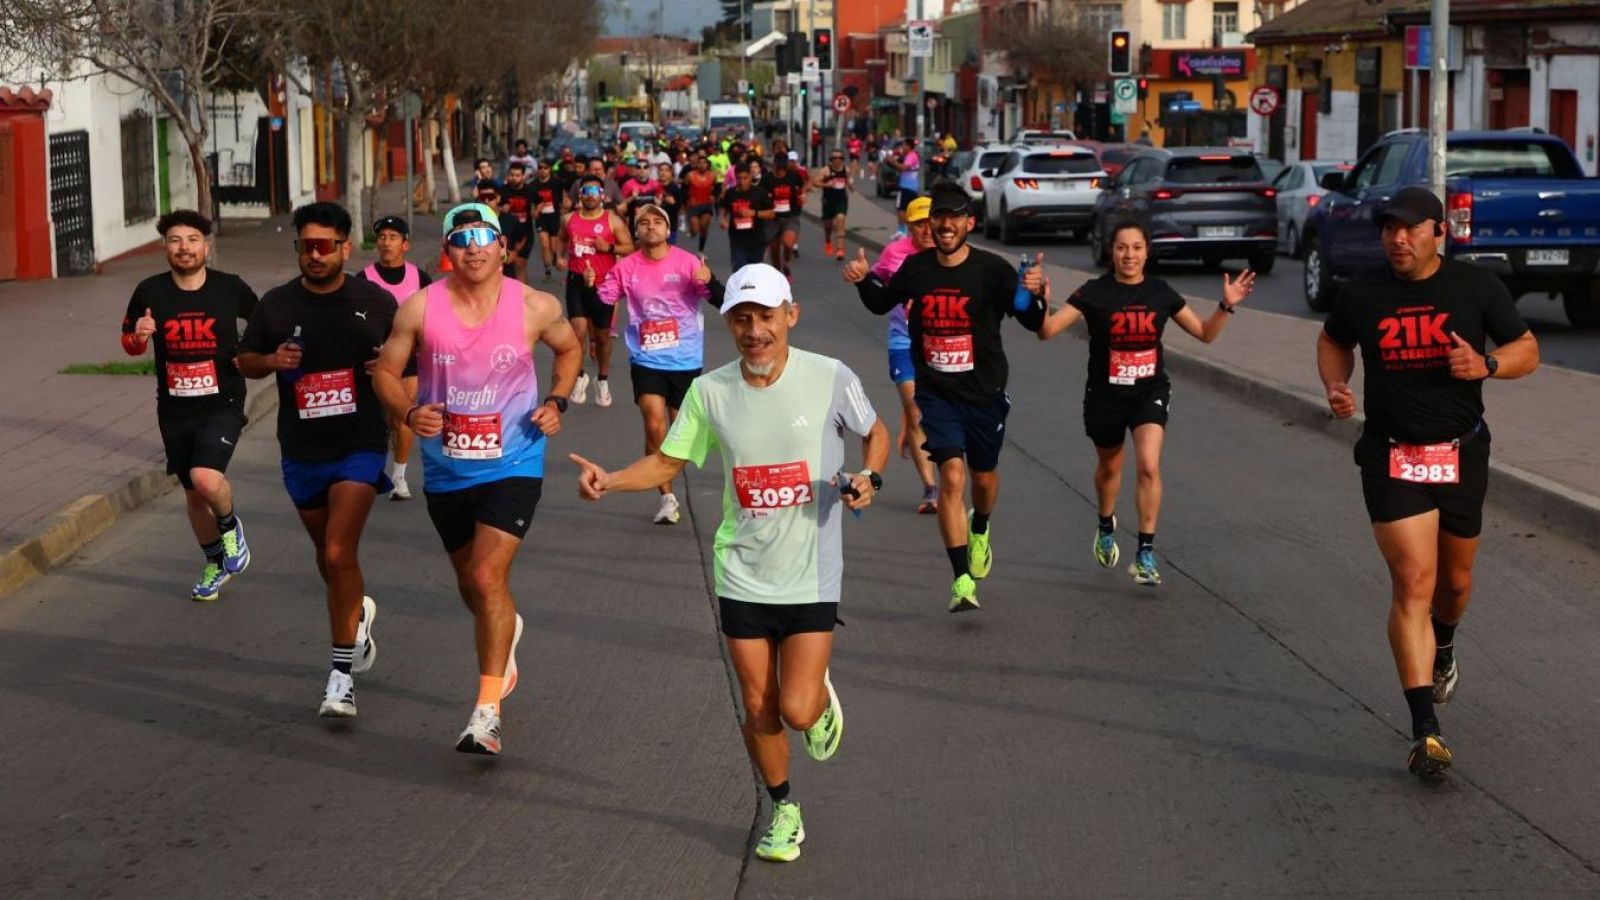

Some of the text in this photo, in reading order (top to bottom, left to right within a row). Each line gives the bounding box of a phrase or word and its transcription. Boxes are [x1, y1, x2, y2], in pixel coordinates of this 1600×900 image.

[921, 295, 970, 318] 21K
[164, 318, 216, 340] 21K
[1110, 312, 1157, 334] 21K
[1378, 313, 1451, 347] 21K
[643, 331, 676, 344] 2025
[930, 351, 971, 364] 2577
[1381, 350, 1399, 361] LA
[1117, 362, 1156, 377] 2802
[173, 374, 214, 389] 2520
[304, 387, 353, 408] 2226
[447, 384, 499, 410] Serghi
[447, 432, 500, 449] 2042
[1401, 463, 1456, 482] 2983
[748, 484, 812, 507] 3092
